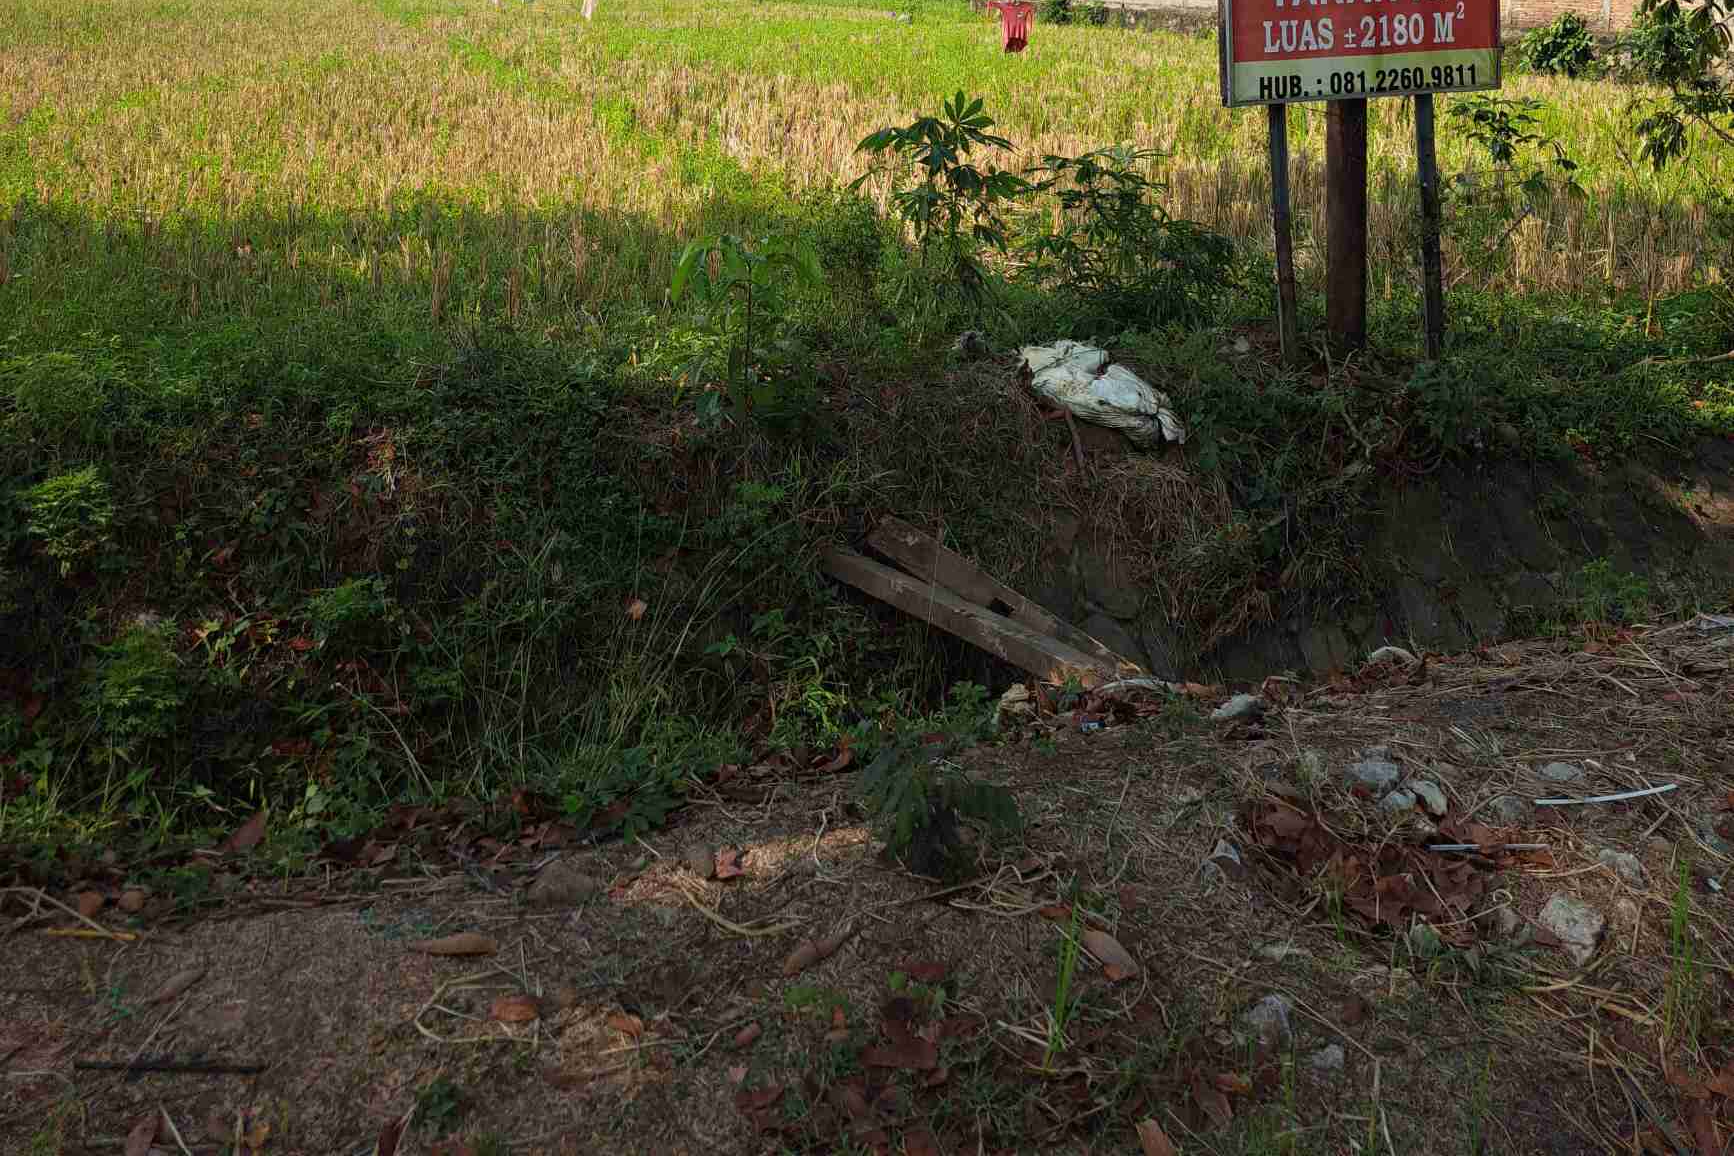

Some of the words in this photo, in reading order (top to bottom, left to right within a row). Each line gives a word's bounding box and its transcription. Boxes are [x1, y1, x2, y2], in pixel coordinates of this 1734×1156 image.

[1263, 17, 1334, 53] LUAS
[1343, 12, 1425, 48] ±2180
[1329, 63, 1477, 95] 081.2260.9811
